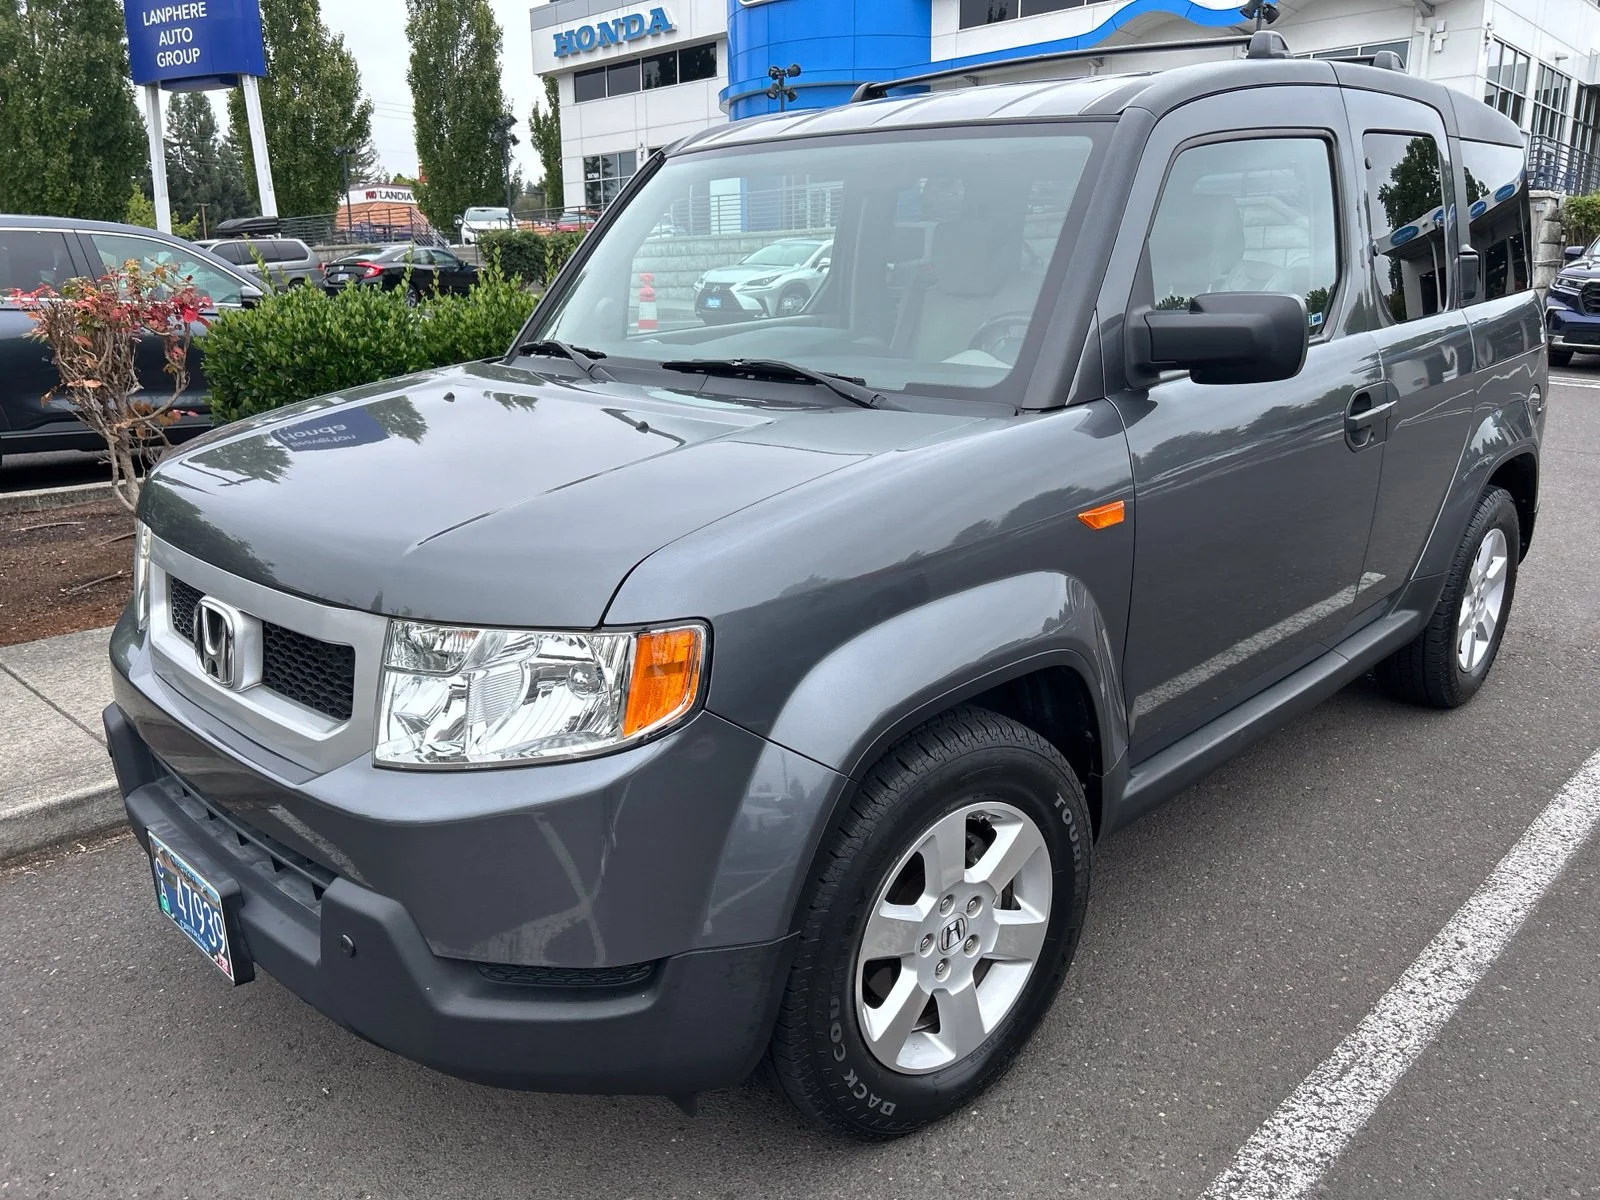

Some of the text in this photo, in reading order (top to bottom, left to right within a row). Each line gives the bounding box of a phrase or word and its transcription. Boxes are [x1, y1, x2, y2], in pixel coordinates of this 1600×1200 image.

[142, 2, 208, 27] LANPHERE
[158, 27, 193, 47] AUTO
[552, 7, 677, 58] HONDA
[156, 48, 201, 68] GROUP
[379, 190, 413, 201] LANDIA
[176, 876, 226, 955] 47939
[843, 1067, 896, 1116] BACK
